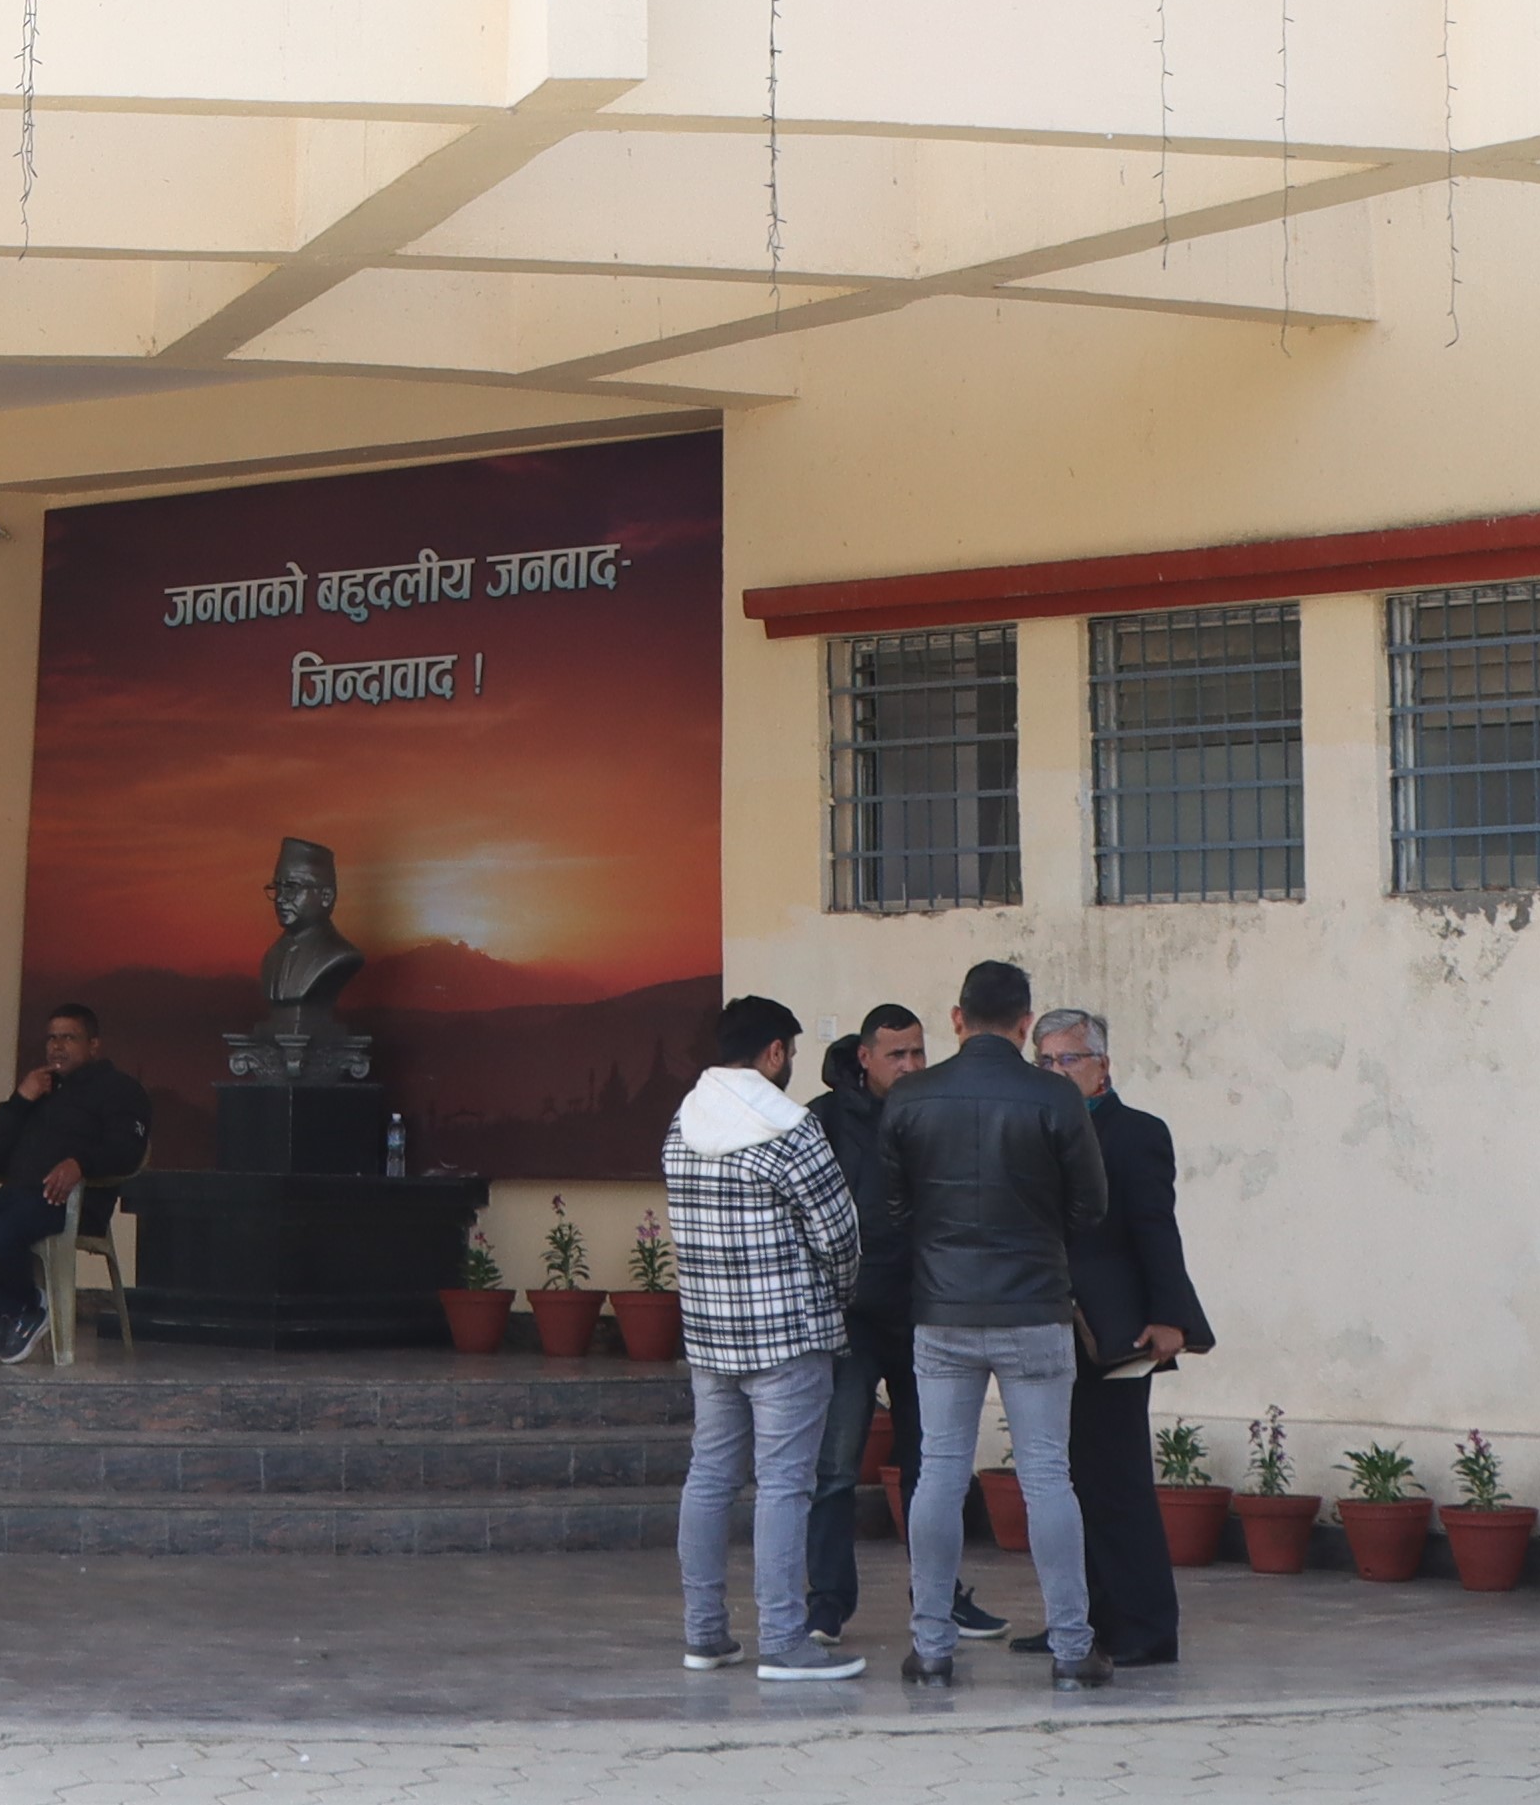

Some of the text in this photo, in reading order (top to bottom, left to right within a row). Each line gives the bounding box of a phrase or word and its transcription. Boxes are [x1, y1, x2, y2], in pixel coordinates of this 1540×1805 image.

[163, 562, 308, 627] जनताको
[317, 548, 476, 622] बहुदलीय
[291, 651, 458, 708] जिन्दावाद
